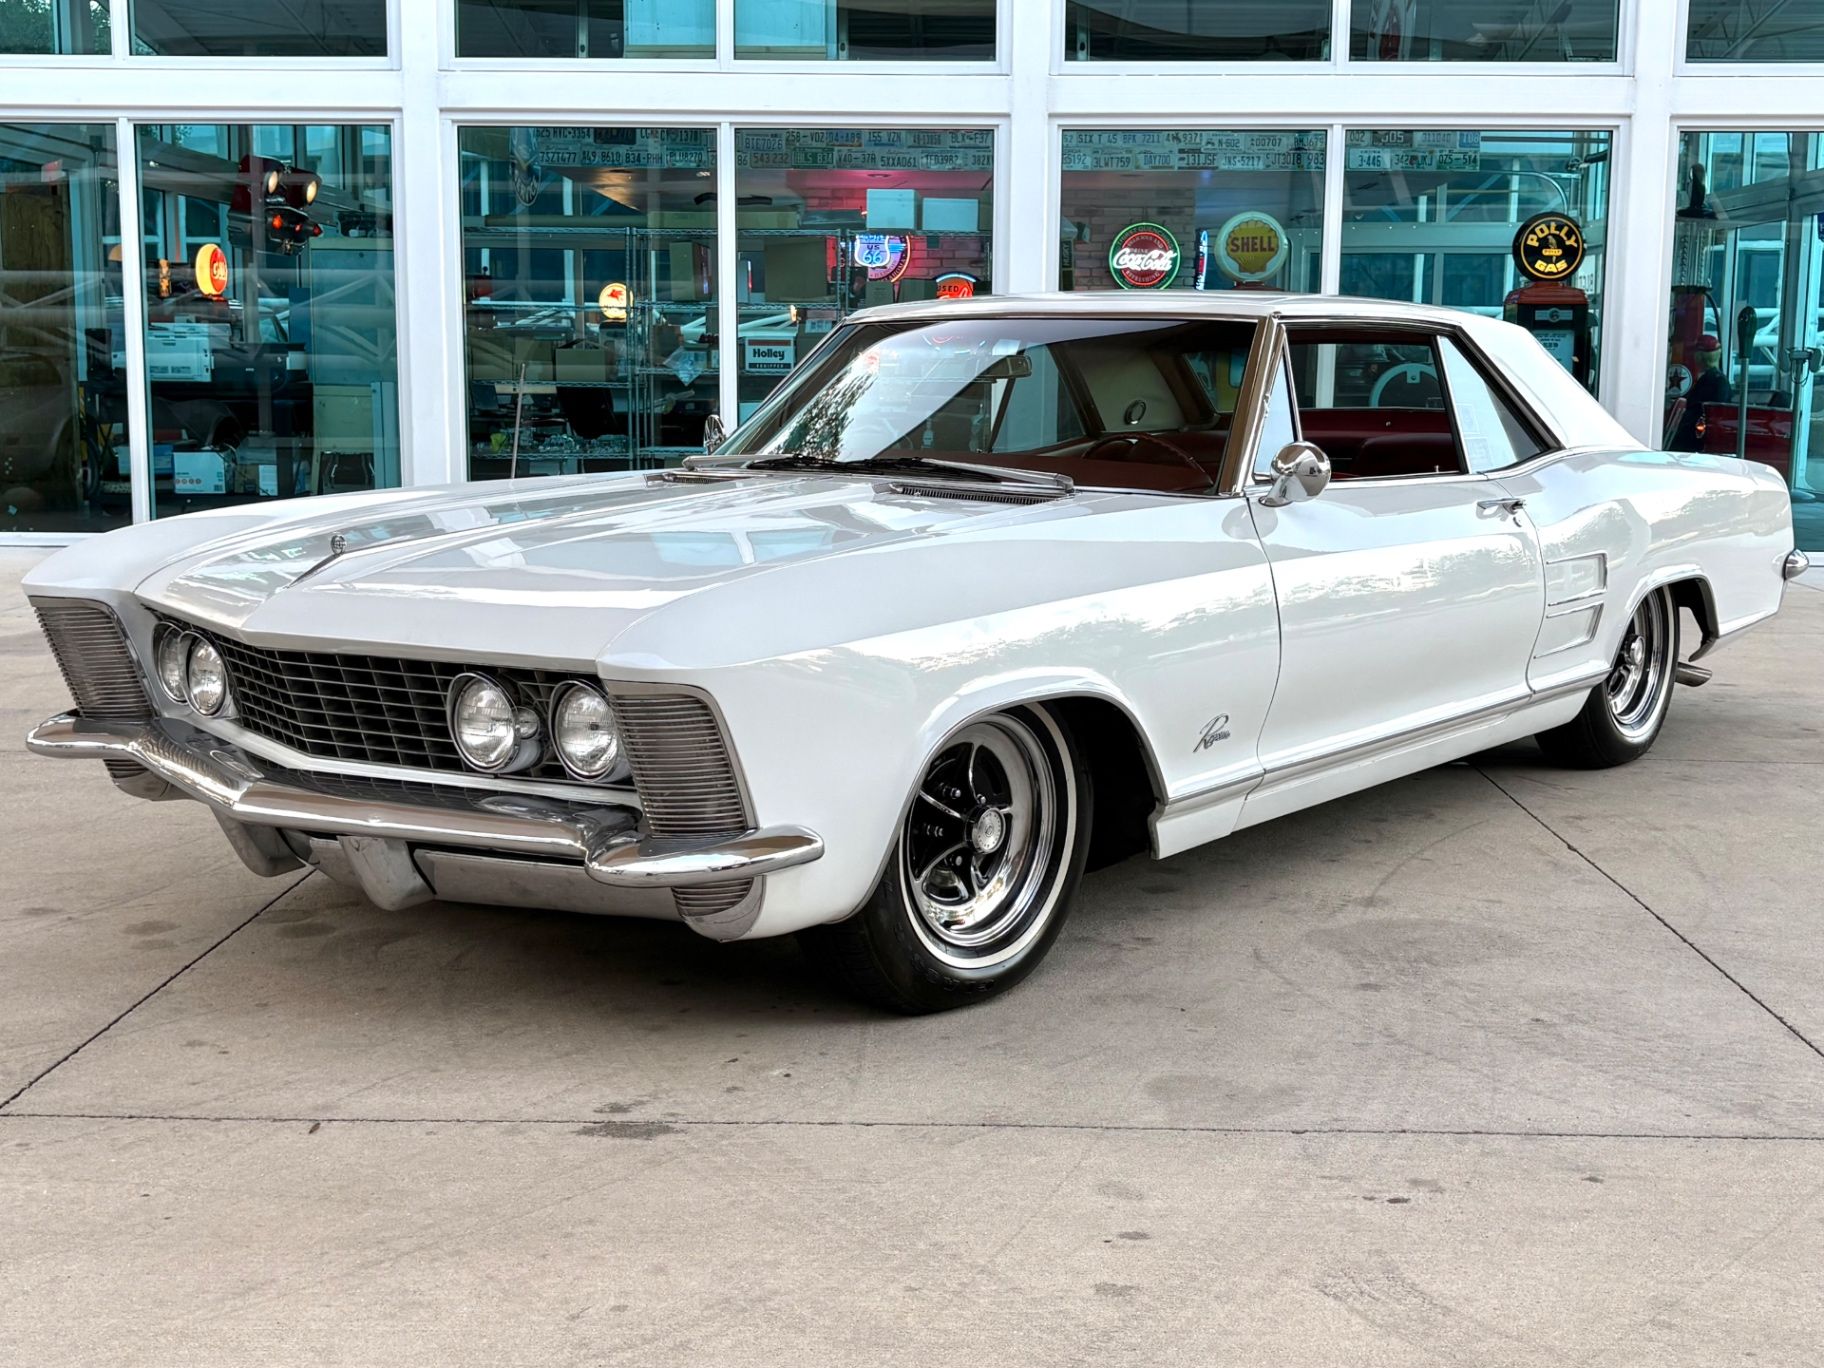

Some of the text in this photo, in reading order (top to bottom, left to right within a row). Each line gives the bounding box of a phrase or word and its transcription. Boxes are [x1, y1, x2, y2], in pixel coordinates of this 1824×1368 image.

[1527, 222, 1578, 248] POLLY
[1230, 236, 1275, 253] SHELL
[863, 249, 883, 264] 66
[1535, 260, 1568, 272] GAS
[752, 348, 785, 361] Holley
